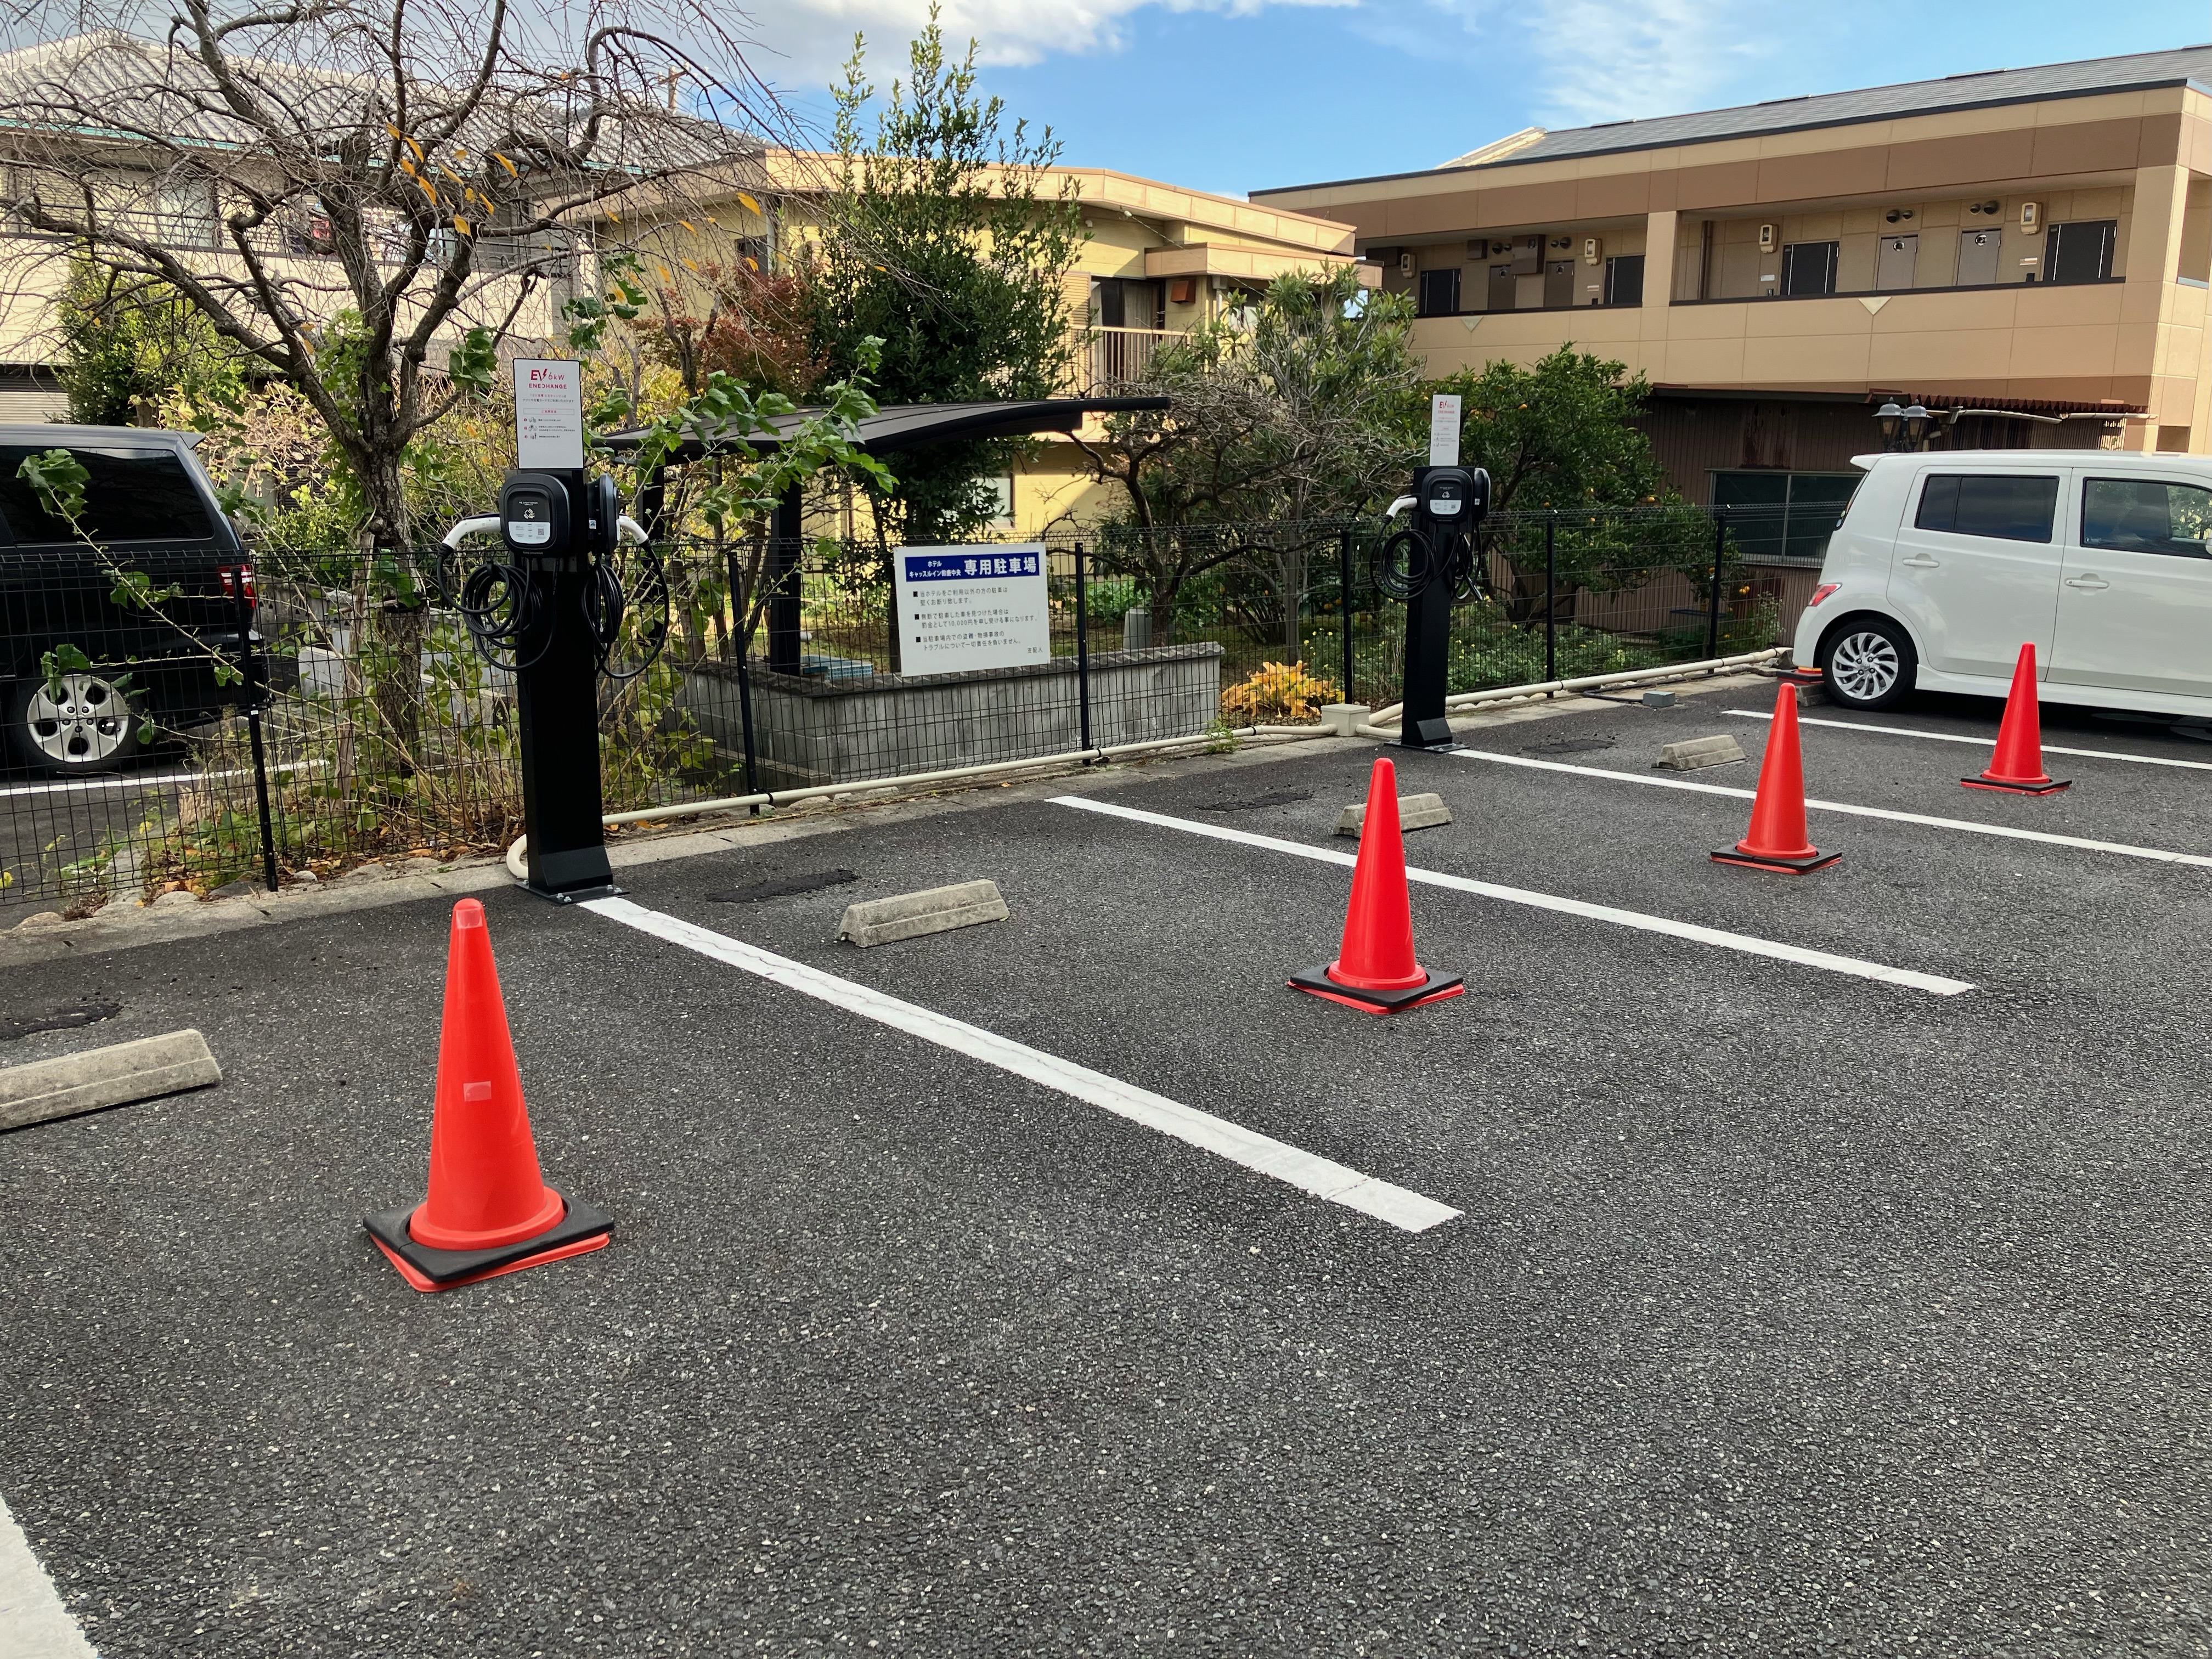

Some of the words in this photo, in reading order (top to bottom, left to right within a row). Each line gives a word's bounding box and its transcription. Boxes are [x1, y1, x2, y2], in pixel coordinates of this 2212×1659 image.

[531, 368, 548, 381] EV
[548, 371, 565, 380] 6kW
[964, 556, 1037, 576] 専用駐車場
[920, 587, 1008, 597] 当ホテルをご利用以外の方の駐車は
[921, 609, 1008, 620] 無断で駐車した車を見つけた場合は
[923, 631, 1005, 642] 当駐車場内での盗難・物損事故の
